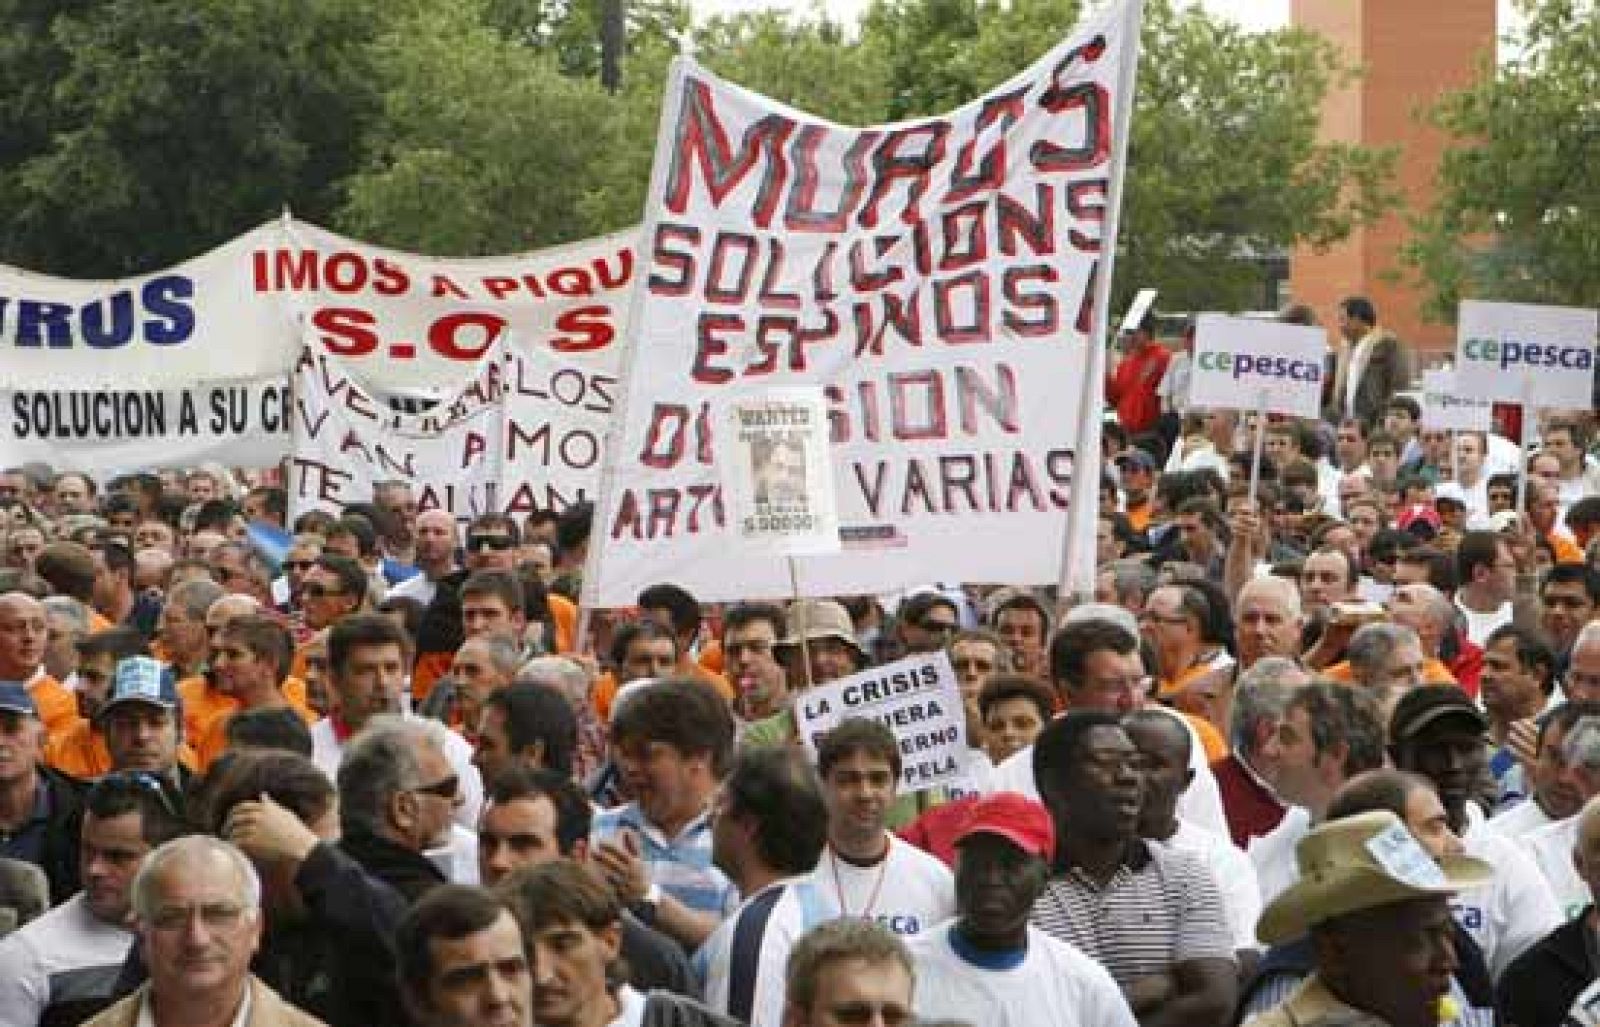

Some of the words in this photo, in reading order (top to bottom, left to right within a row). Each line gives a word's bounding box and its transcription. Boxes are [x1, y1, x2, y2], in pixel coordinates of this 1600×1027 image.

[252, 249, 411, 295] IMOS
[1198, 347, 1320, 382] cepesca
[1464, 335, 1592, 369] cepesca
[13, 390, 166, 438] SOLUCION
[178, 389, 199, 436] A
[208, 386, 248, 435] SU
[853, 449, 1076, 514] VARIAS
[805, 698, 831, 720] LA
[842, 665, 939, 706] CRISIS
